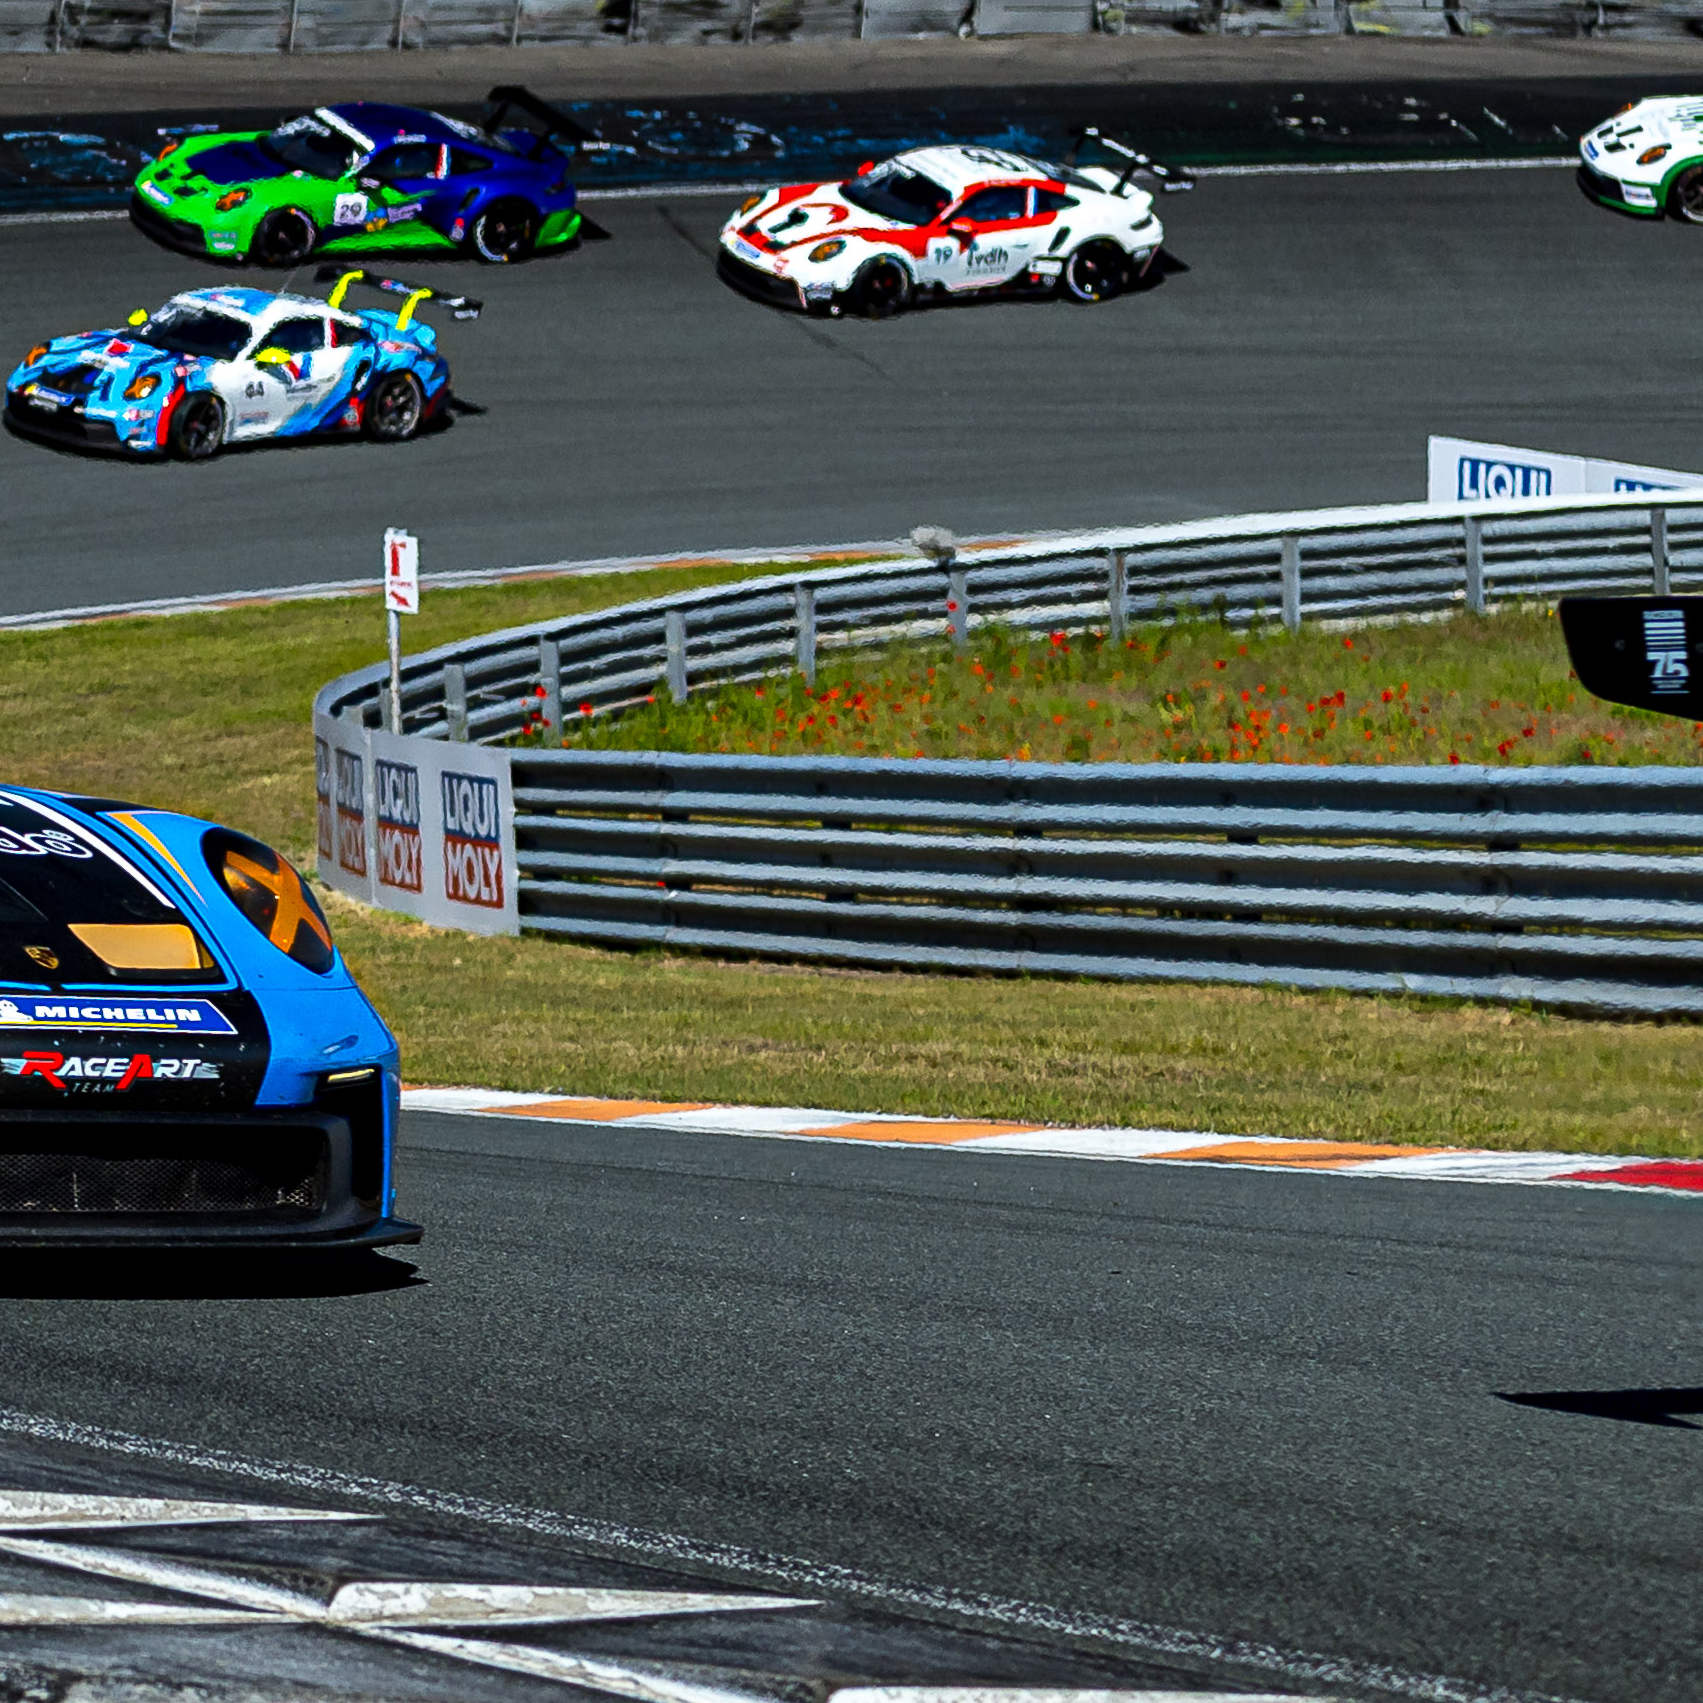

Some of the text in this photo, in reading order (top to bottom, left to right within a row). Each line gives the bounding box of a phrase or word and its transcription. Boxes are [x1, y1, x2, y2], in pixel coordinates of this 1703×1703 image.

[1647, 651, 1689, 677] 75
[377, 764, 419, 824] LIQUI
[444, 776, 496, 838] LIQUI
[379, 827, 420, 886] MOLY
[447, 840, 500, 902] MOLY
[35, 1004, 202, 1022] MICHELIN
[72, 1081, 116, 1094] TEAM
